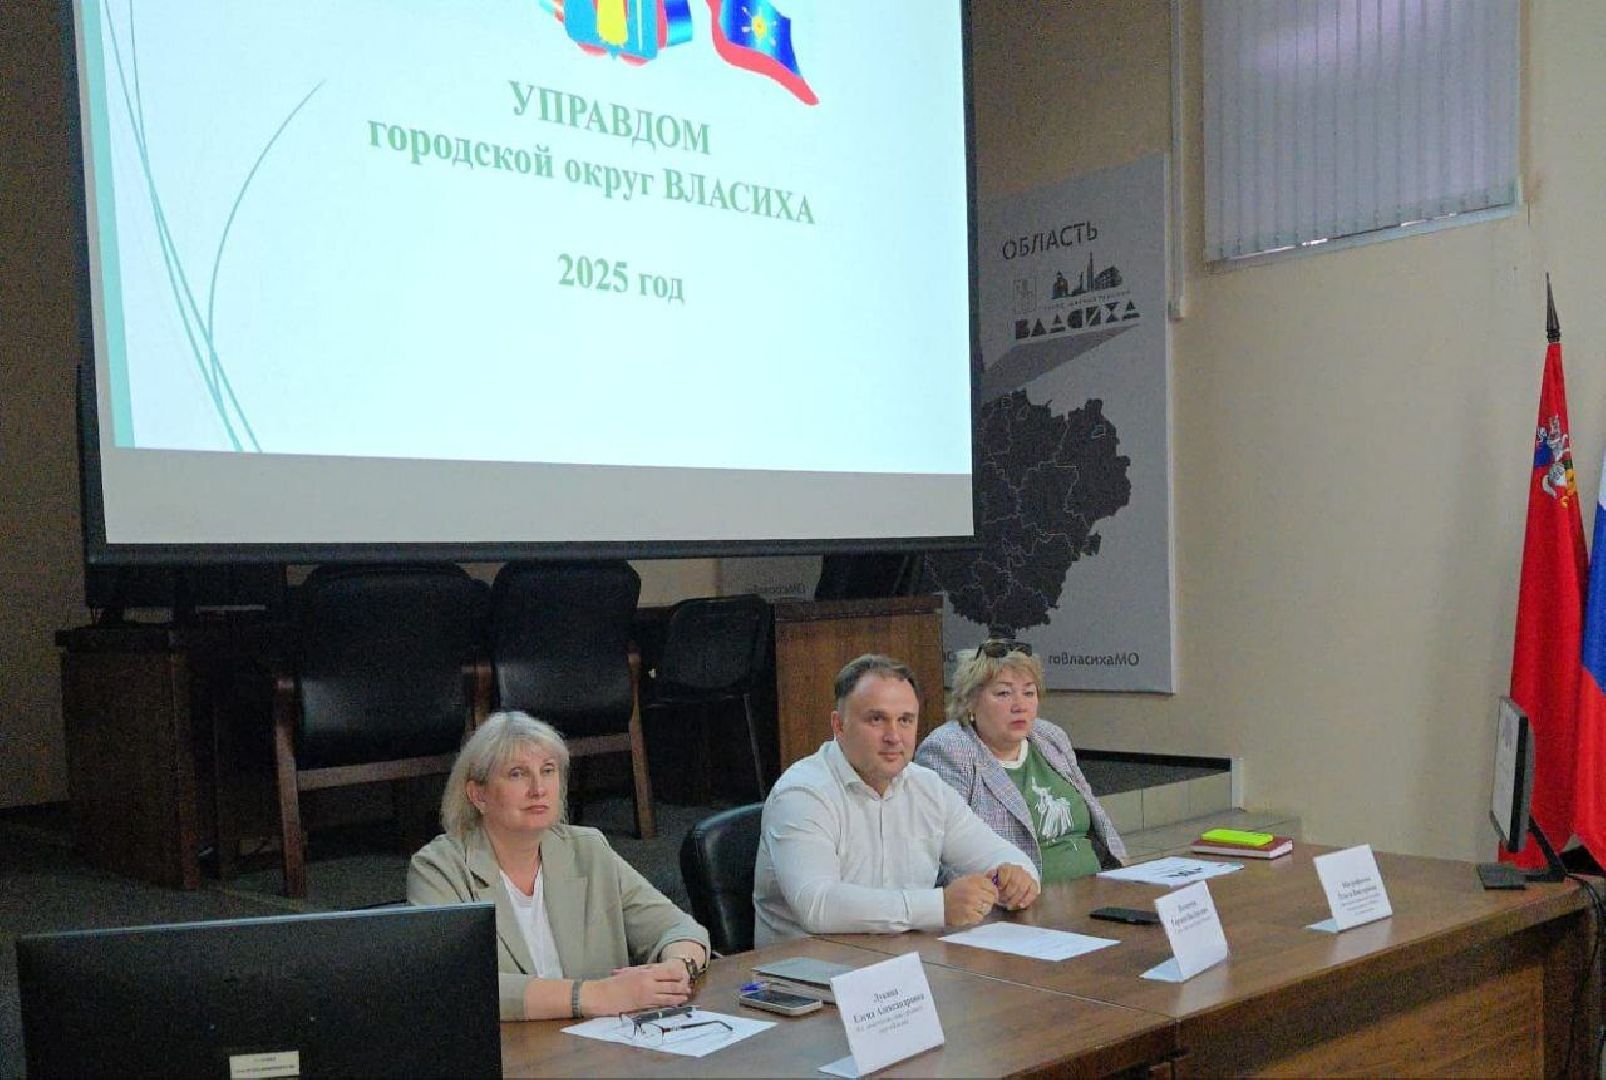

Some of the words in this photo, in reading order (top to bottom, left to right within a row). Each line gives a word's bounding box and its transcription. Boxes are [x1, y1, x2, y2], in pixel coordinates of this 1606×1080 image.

[507, 81, 711, 155] УПРАВДОМ
[367, 120, 554, 179] городской
[566, 158, 654, 201] округ
[663, 168, 815, 224] ВЛАСИХА
[1002, 221, 1098, 260] ОБЛАСТЬ
[557, 253, 629, 293] 2025
[638, 272, 686, 304] год
